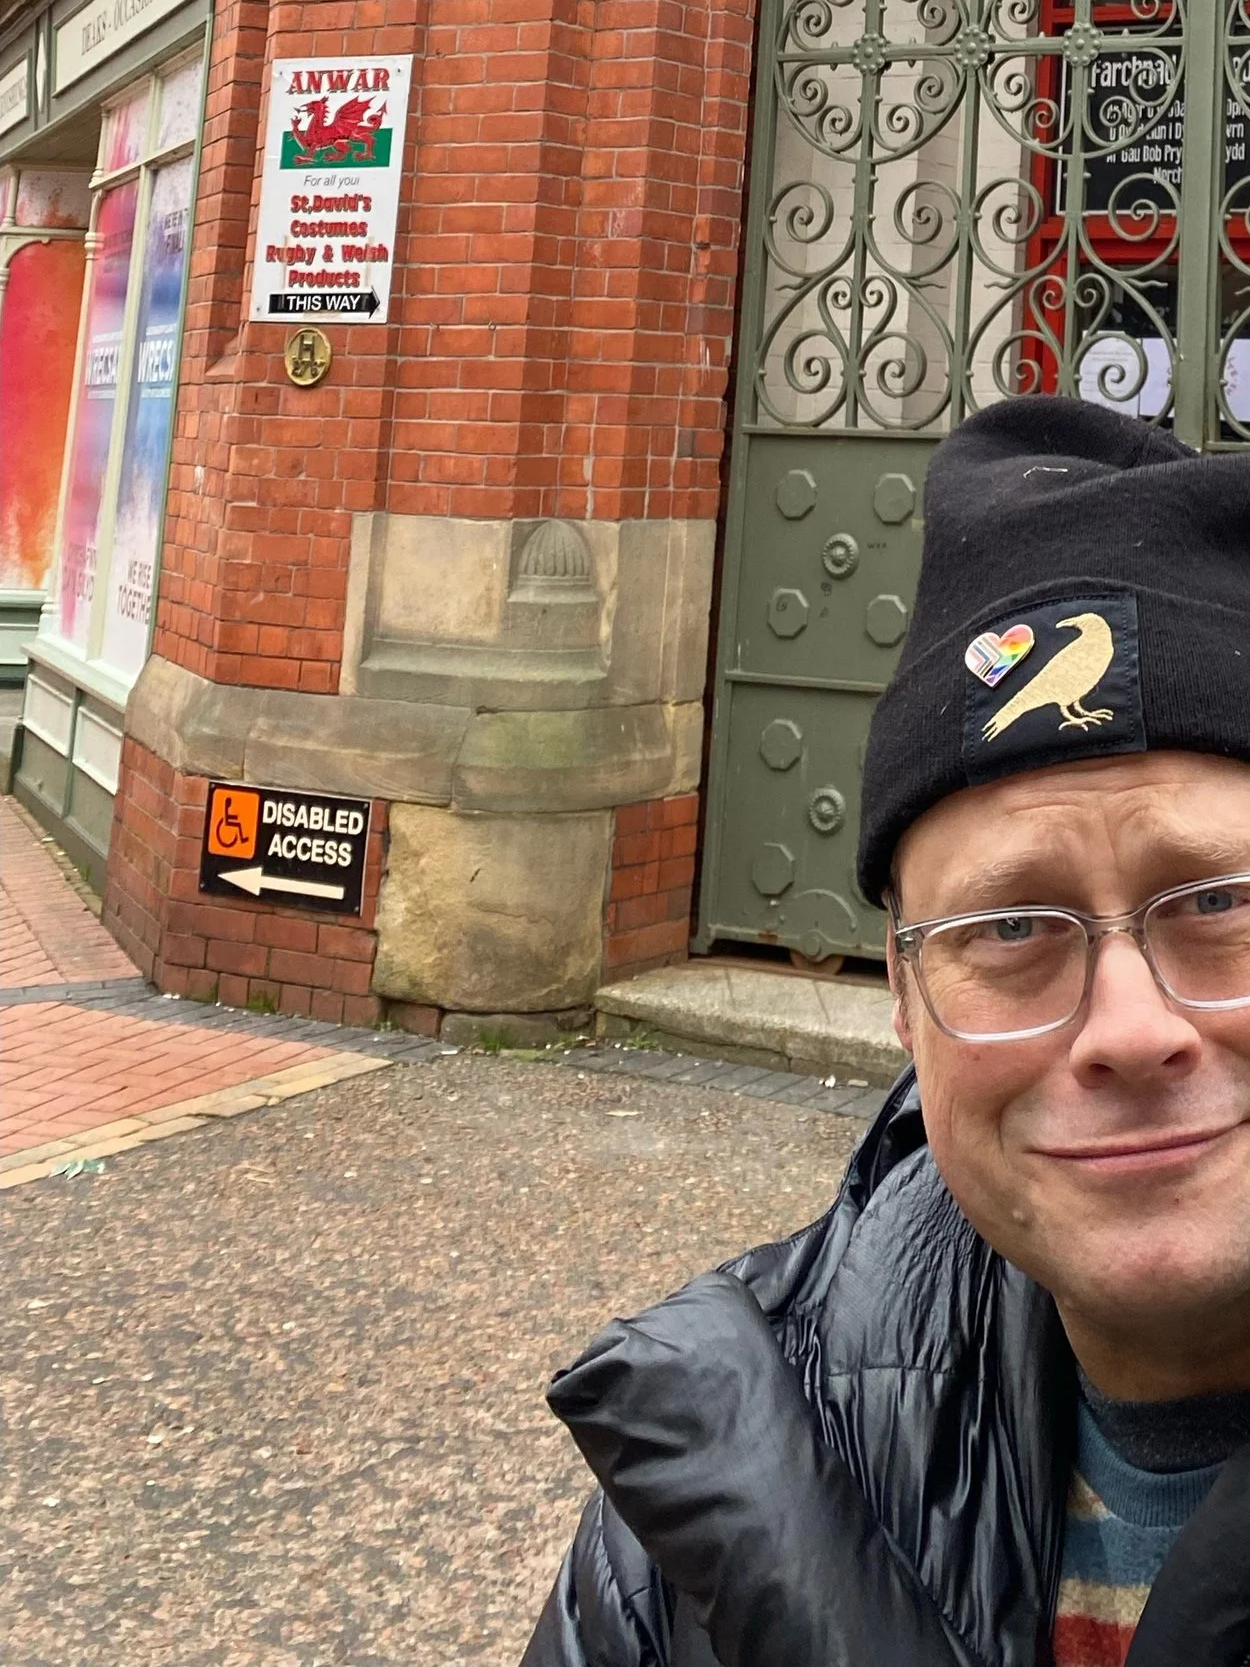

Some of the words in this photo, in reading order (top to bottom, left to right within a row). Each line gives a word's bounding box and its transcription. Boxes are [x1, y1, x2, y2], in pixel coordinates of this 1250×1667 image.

[286, 67, 391, 95] ANWAR
[304, 175, 322, 186] For
[324, 175, 335, 185] all
[290, 220, 368, 238] Costumes
[266, 244, 317, 266] Rugby
[322, 244, 334, 263] &
[341, 243, 389, 263] Welsh
[288, 269, 361, 288] Products
[286, 295, 322, 311] THIS
[325, 295, 361, 310] WAY
[117, 584, 152, 625] TOGETHE
[263, 801, 364, 836] DISABLED
[268, 833, 352, 868] ACCESS
